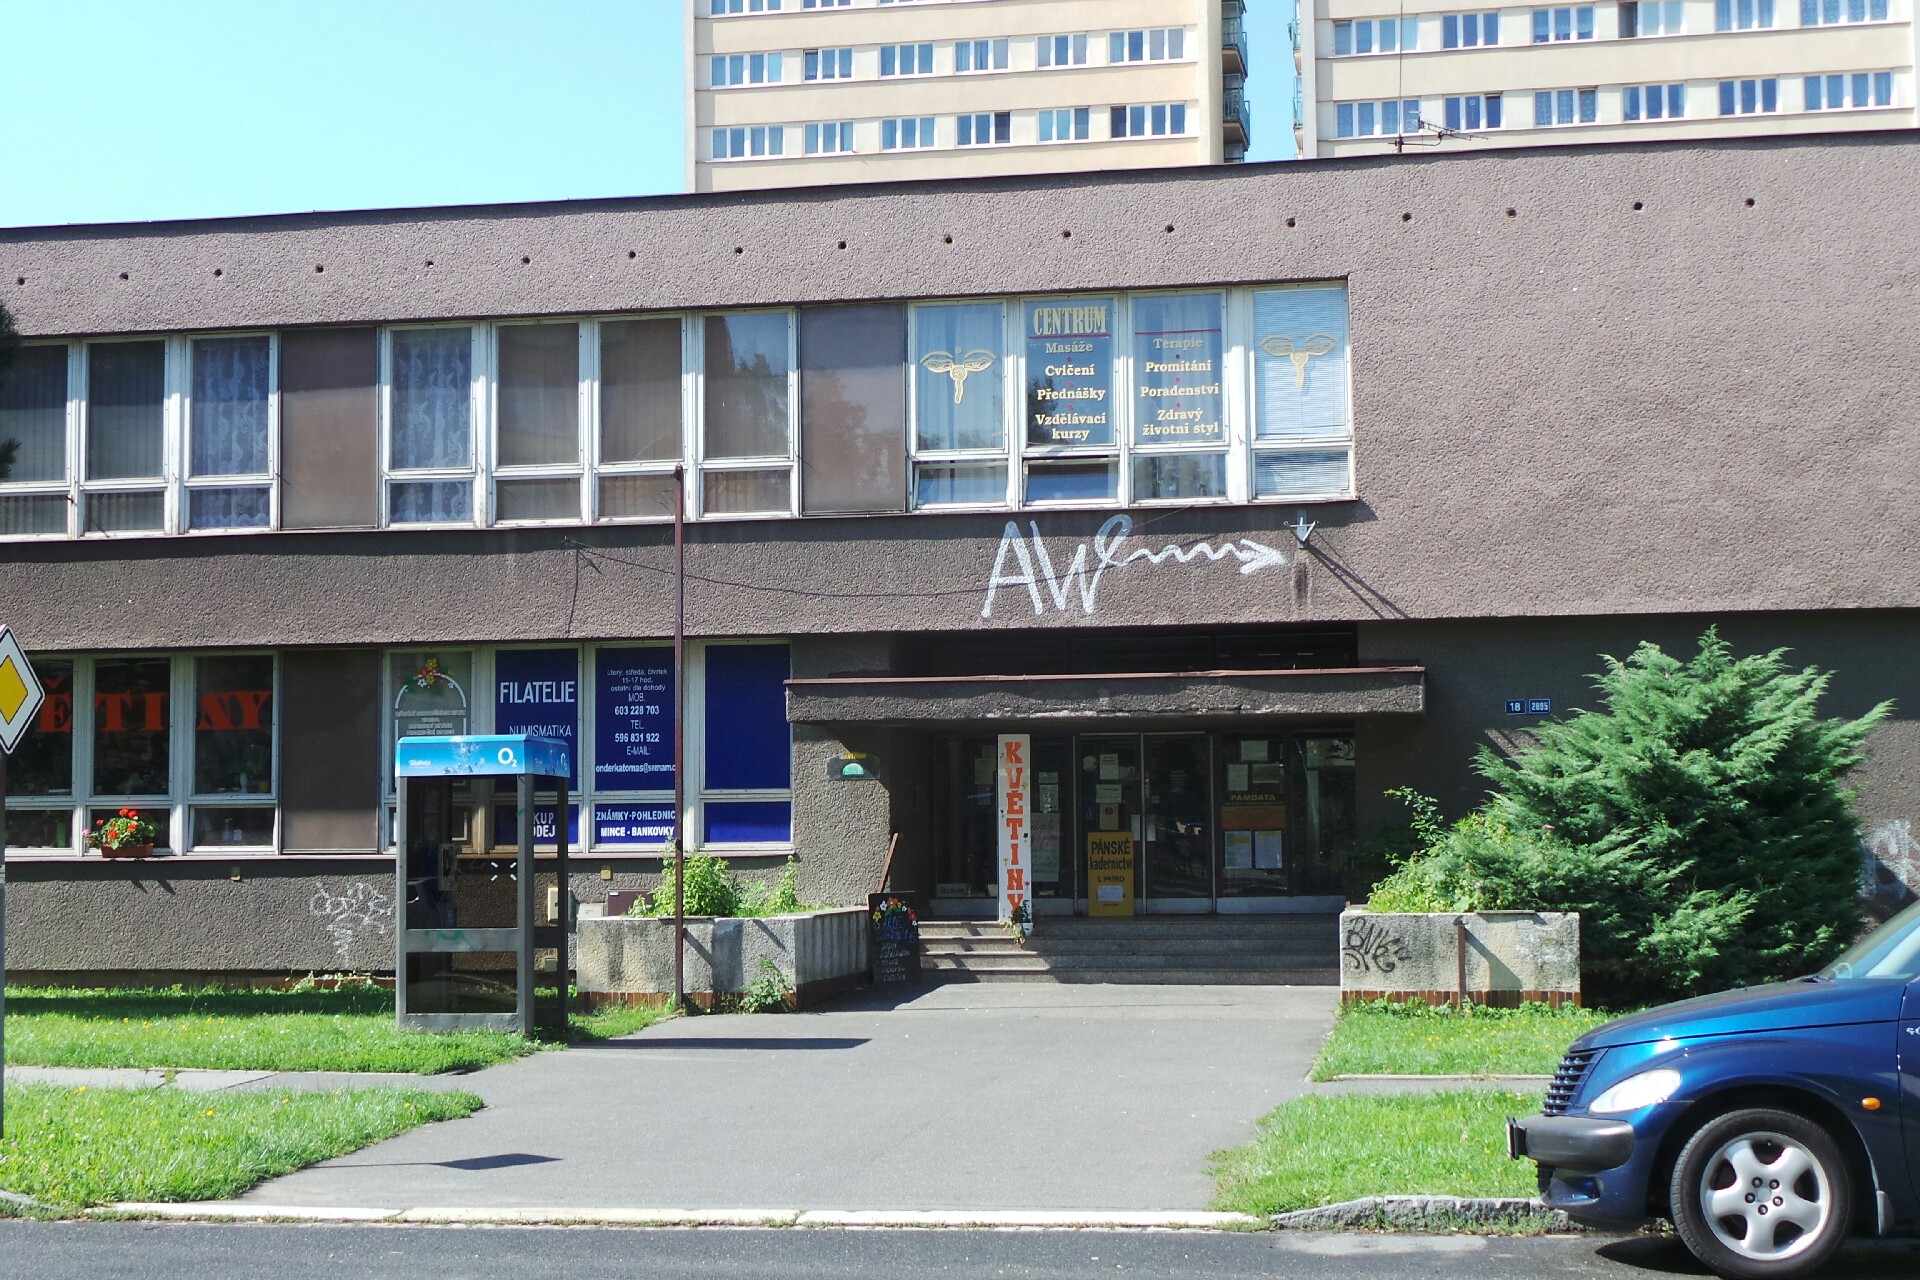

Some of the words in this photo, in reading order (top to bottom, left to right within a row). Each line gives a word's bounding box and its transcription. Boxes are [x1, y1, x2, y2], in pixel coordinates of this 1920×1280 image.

[1033, 306, 1107, 336] CENTRUM
[1045, 341, 1094, 353] Masáže
[1153, 338, 1203, 351] Terapie
[1045, 364, 1095, 376] Cvičení
[1145, 360, 1212, 372] Promítání
[1037, 388, 1106, 401] Přednášky
[1140, 383, 1219, 397] Poradenství
[1035, 413, 1106, 425] Vzdělávací
[1157, 408, 1203, 421] Zdravý
[1052, 428, 1090, 441] kurzy
[1142, 423, 1189, 436] životní
[1193, 422, 1219, 435] styl
[500, 681, 575, 703] FILATELIE
[614, 706, 629, 715] 603
[646, 706, 660, 715] 703
[509, 724, 572, 737] NUMISMATIKA
[614, 733, 629, 743] 596
[630, 733, 644, 743] 831
[646, 733, 660, 743] 922
[600, 827, 626, 837] MINCE
[631, 826, 675, 837] BANKOVKY
[1091, 838, 1130, 855] PÁNSKÉ
